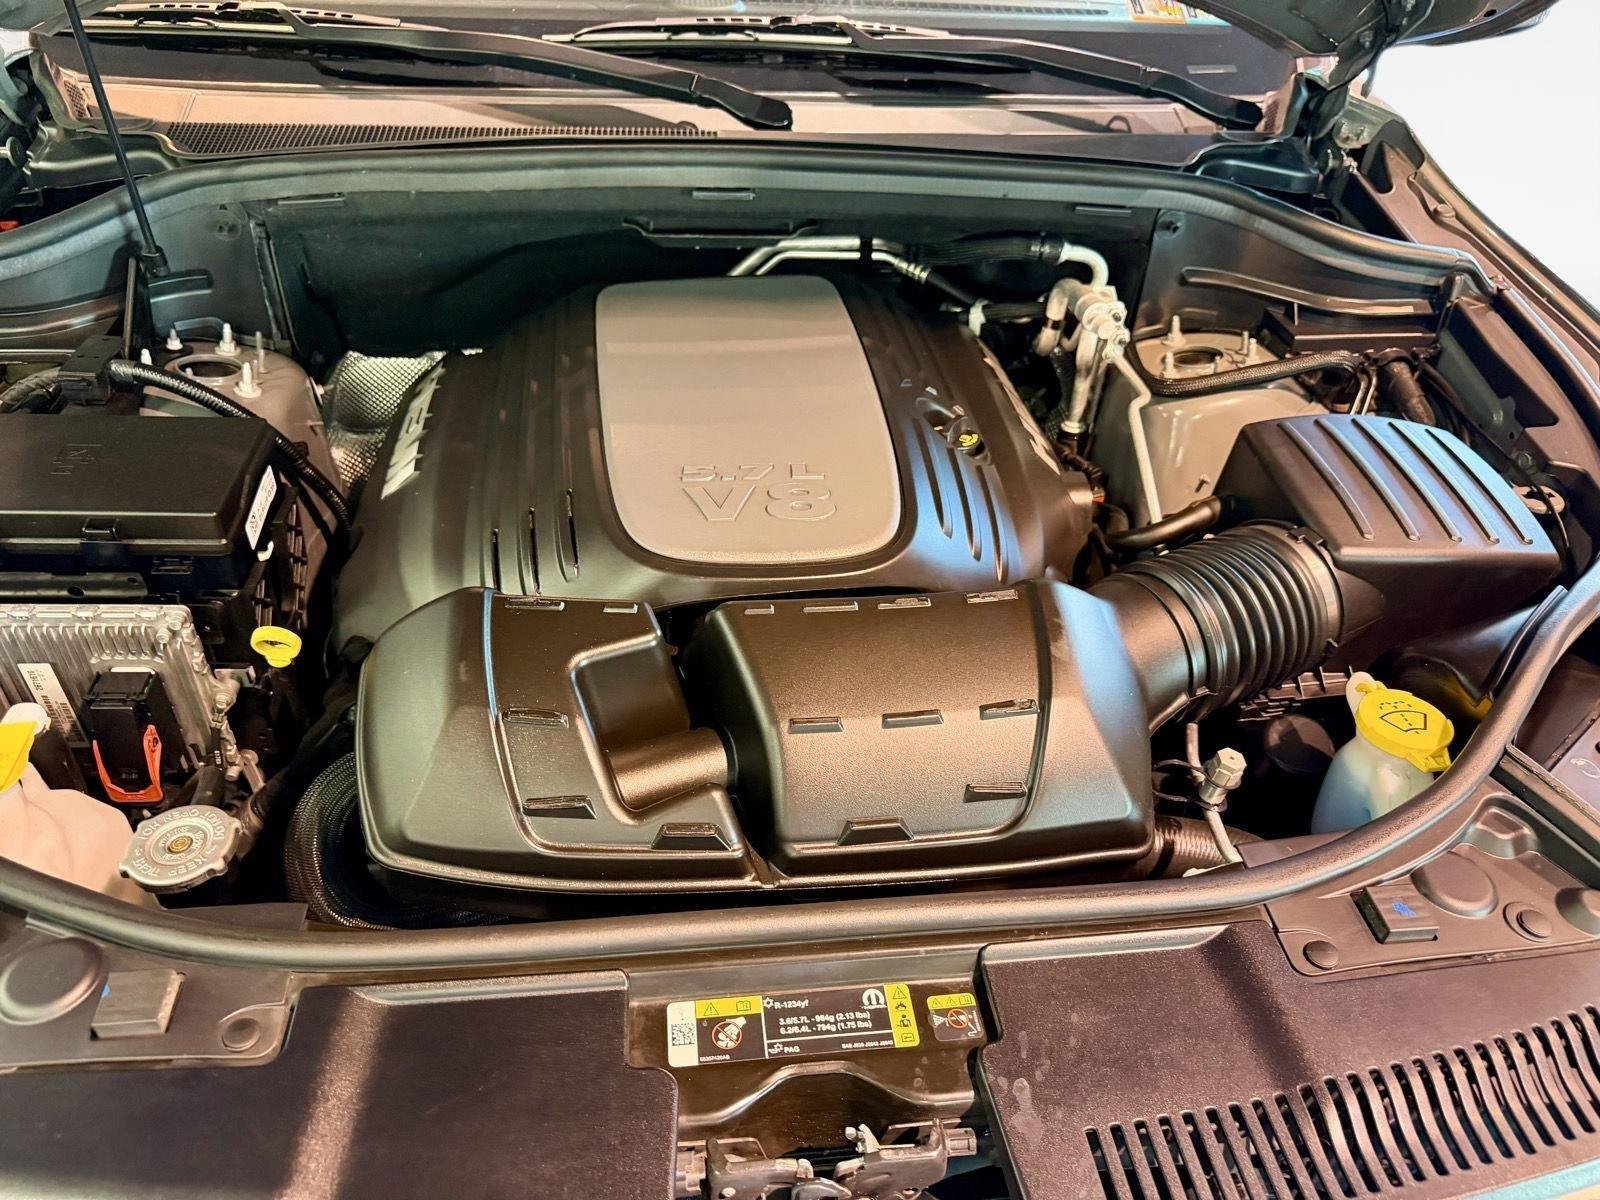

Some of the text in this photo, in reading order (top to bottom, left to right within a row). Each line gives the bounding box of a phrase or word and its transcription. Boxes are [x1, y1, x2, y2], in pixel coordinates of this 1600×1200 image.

[681, 482, 837, 521] V8
[167, 855, 208, 876] KEEP
[774, 999, 809, 1010] R-1234yf
